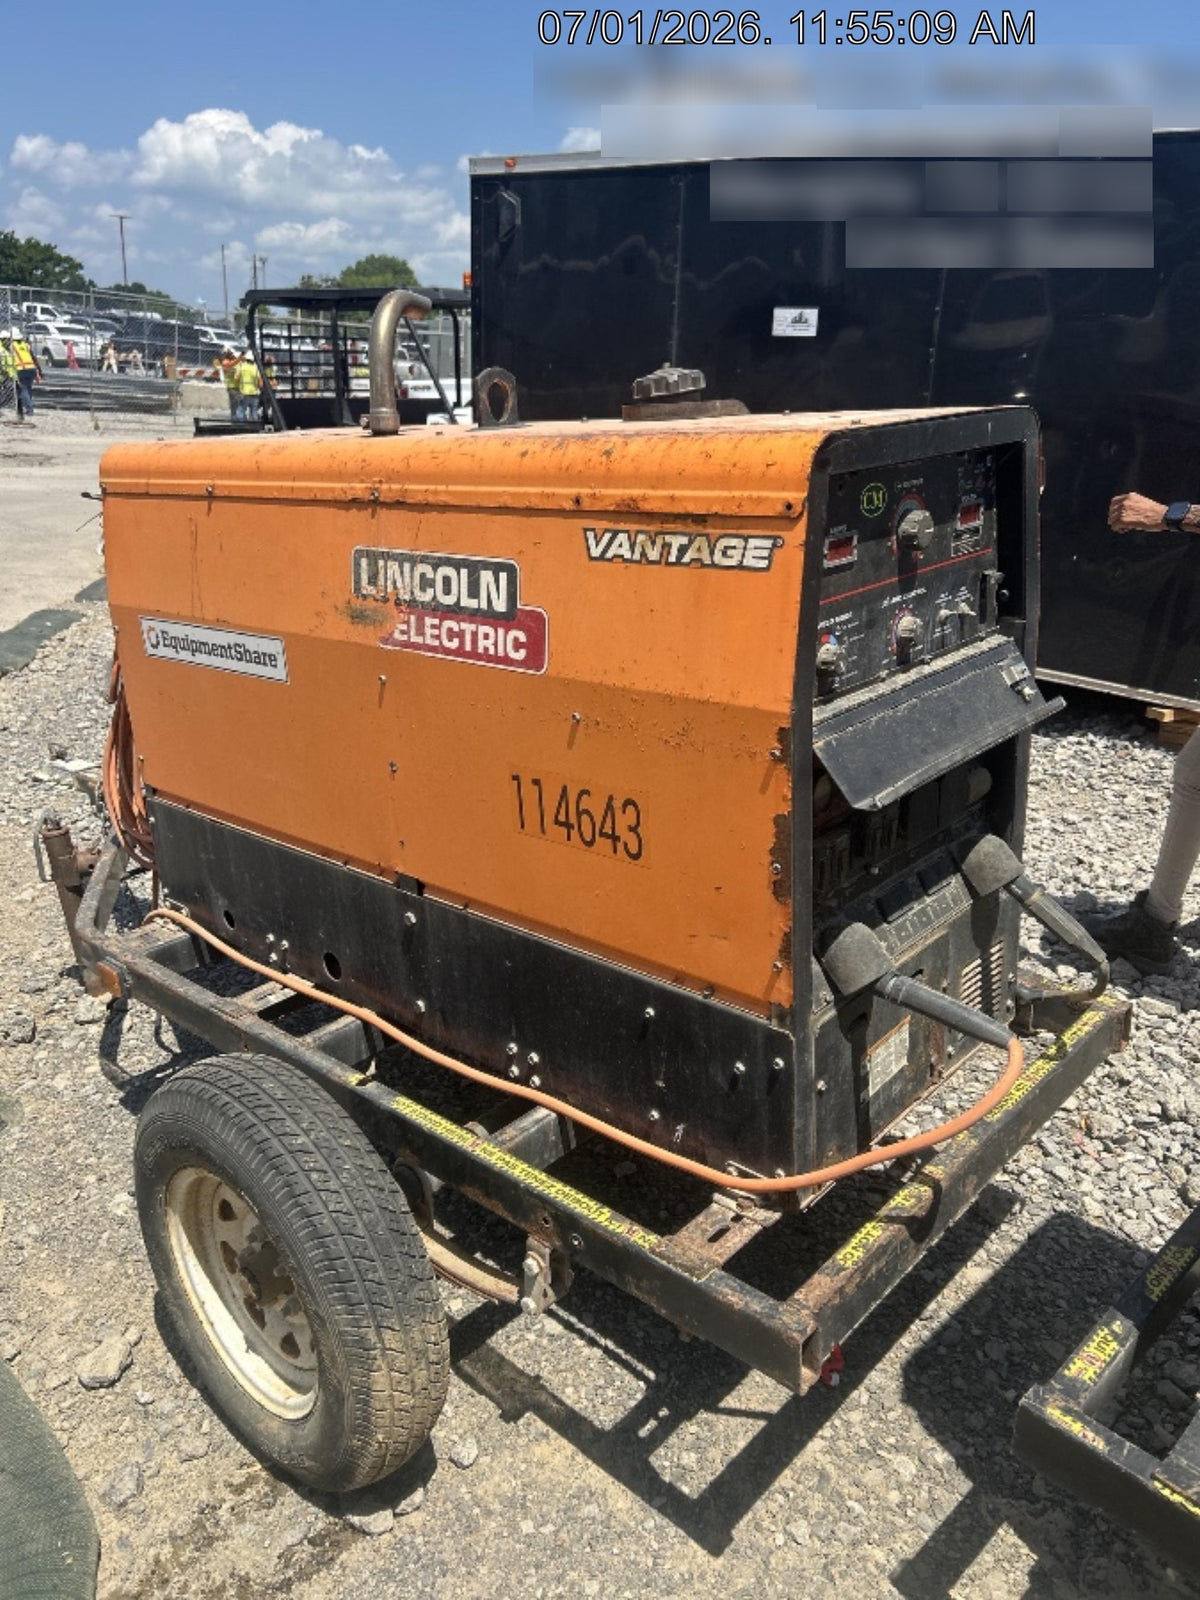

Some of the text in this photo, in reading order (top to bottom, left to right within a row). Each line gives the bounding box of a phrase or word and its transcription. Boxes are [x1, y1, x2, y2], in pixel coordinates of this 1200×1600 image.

[584, 528, 775, 571] VANTAGE
[359, 557, 508, 613] LINCOLN
[160, 629, 278, 669] EquipmentShare
[511, 774, 643, 861] 114643
